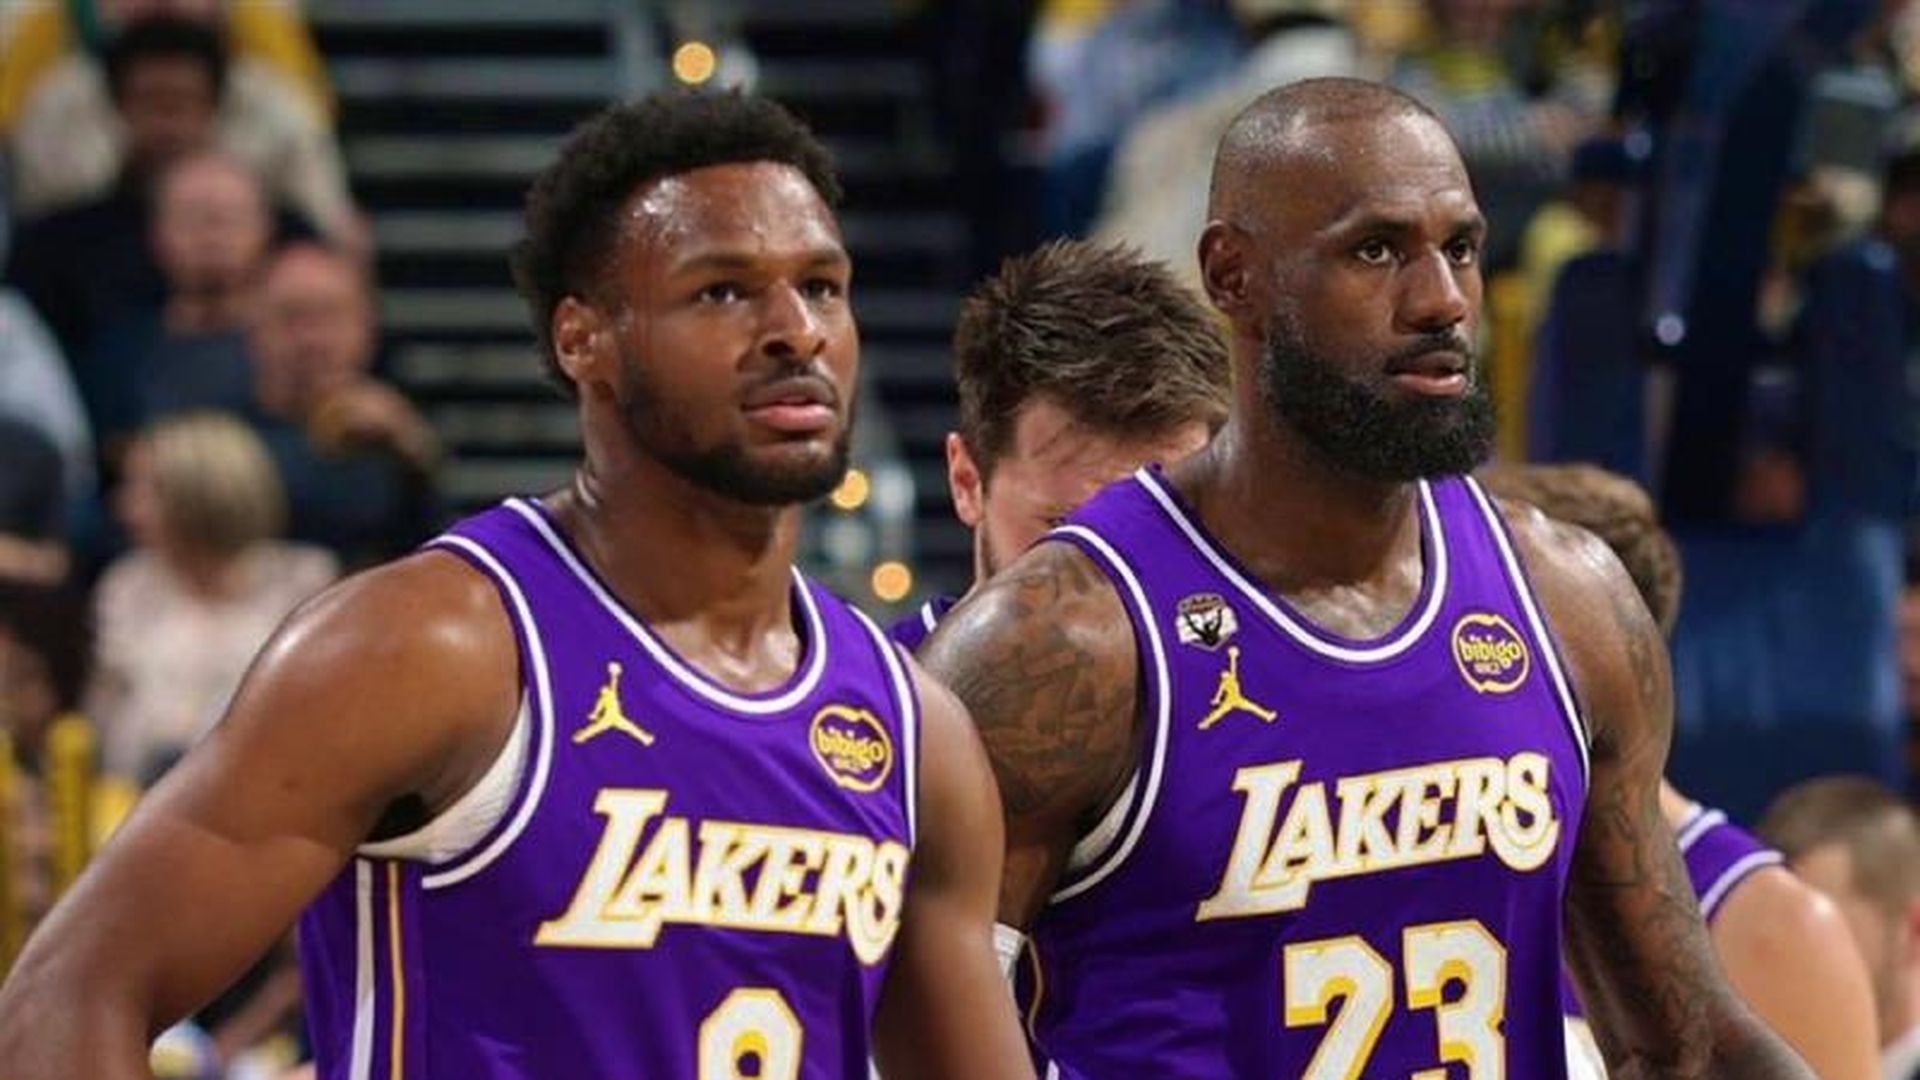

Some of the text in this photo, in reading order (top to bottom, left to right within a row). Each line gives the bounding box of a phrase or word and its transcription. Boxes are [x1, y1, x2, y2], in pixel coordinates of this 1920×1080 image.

[1458, 634, 1521, 669] bibigo
[533, 788, 910, 965] LAKERS
[1195, 751, 1559, 921] LAKERS
[1284, 919, 1508, 1080] 23
